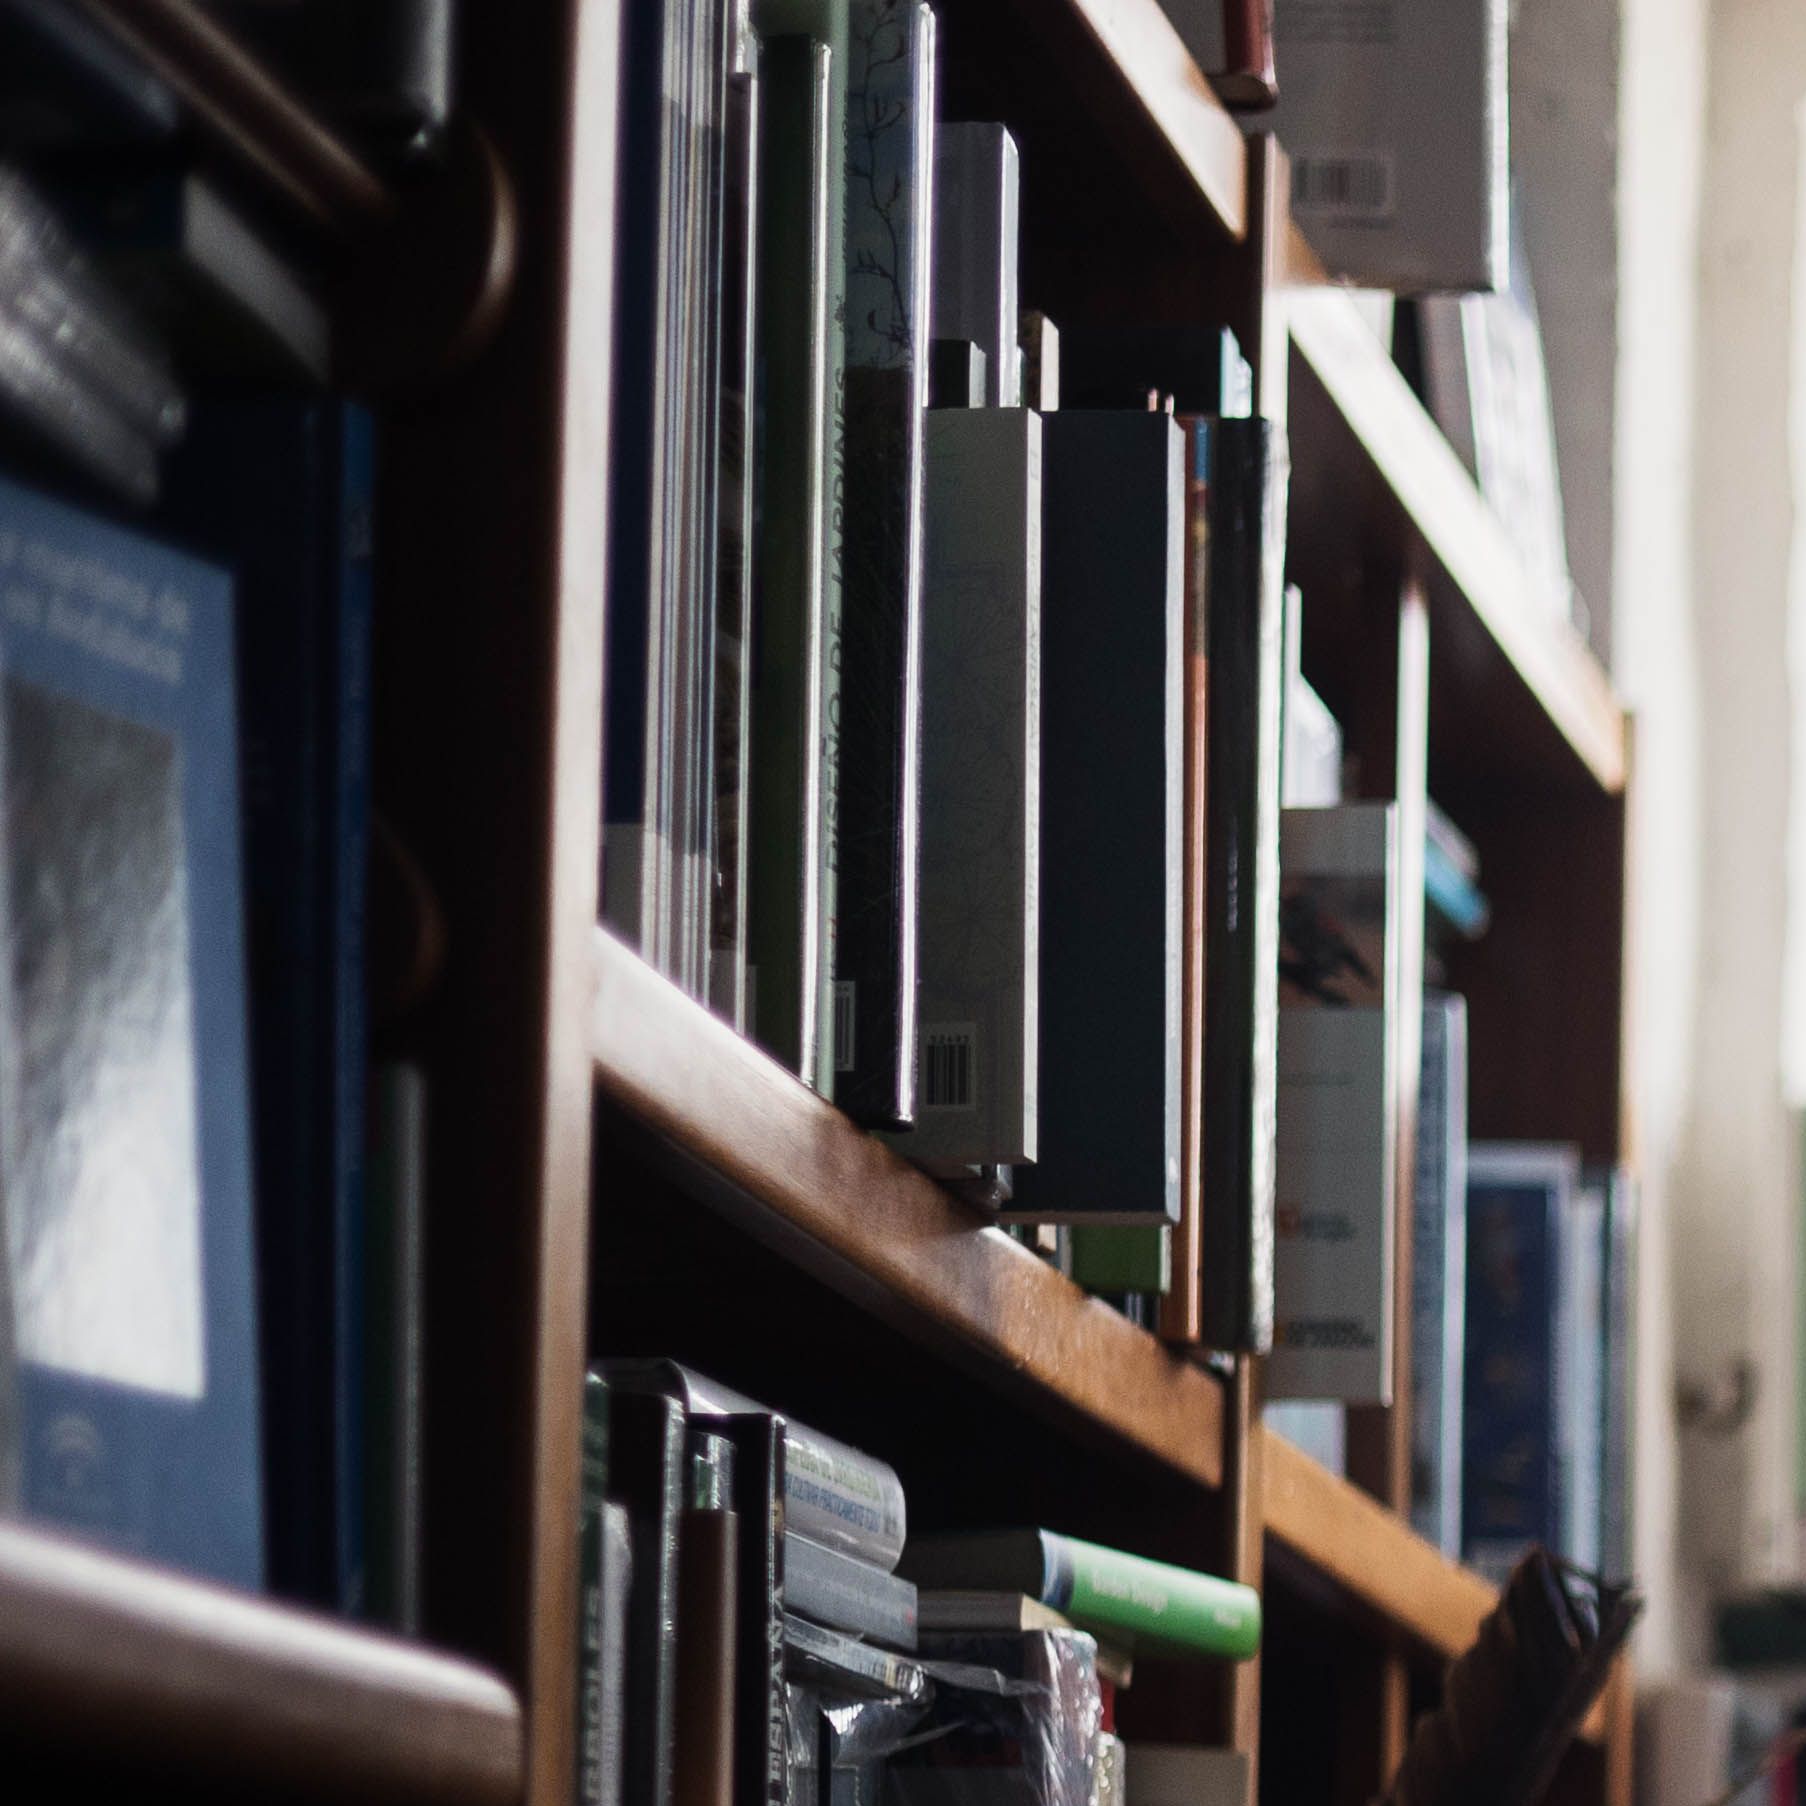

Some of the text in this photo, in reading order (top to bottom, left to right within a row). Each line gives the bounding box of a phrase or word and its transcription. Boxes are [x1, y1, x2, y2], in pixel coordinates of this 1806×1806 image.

[829, 612, 843, 674] DE
[822, 690, 841, 874] DISEÑO
[764, 1584, 783, 1784] ESPAÑA
